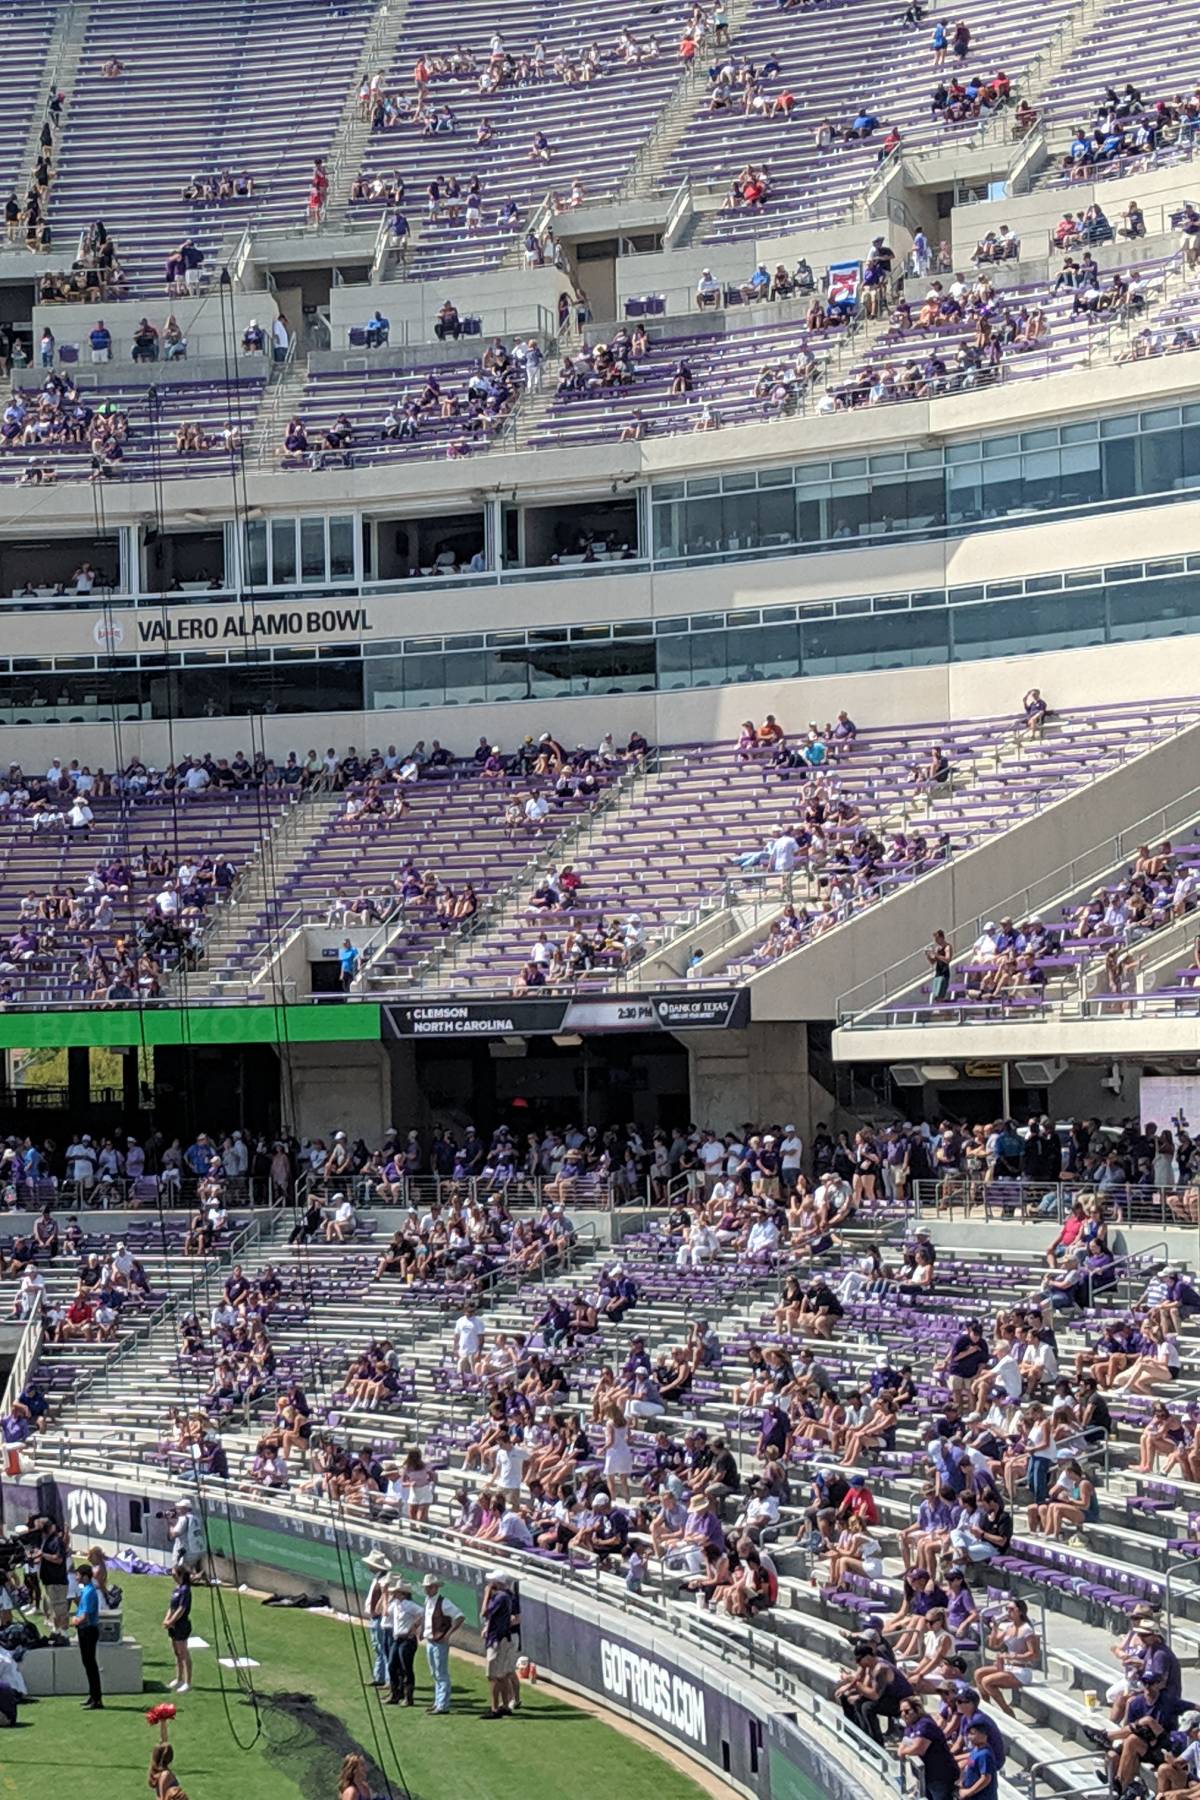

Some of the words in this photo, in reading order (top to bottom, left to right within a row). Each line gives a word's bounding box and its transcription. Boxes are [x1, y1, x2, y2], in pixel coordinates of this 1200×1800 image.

[138, 619, 218, 643] VALERO
[224, 612, 302, 637] ALAMO
[307, 609, 373, 633] BOWL
[413, 1007, 468, 1019] CLEMSON
[669, 1003, 690, 1012] BANK
[691, 1003, 701, 1011] OF
[703, 1002, 728, 1011] TEXAS
[413, 1021, 453, 1032] NORTH
[455, 1019, 514, 1031] CAROLINA
[67, 1489, 107, 1535] TCU
[601, 1639, 707, 1746] GOFROGS.COM
